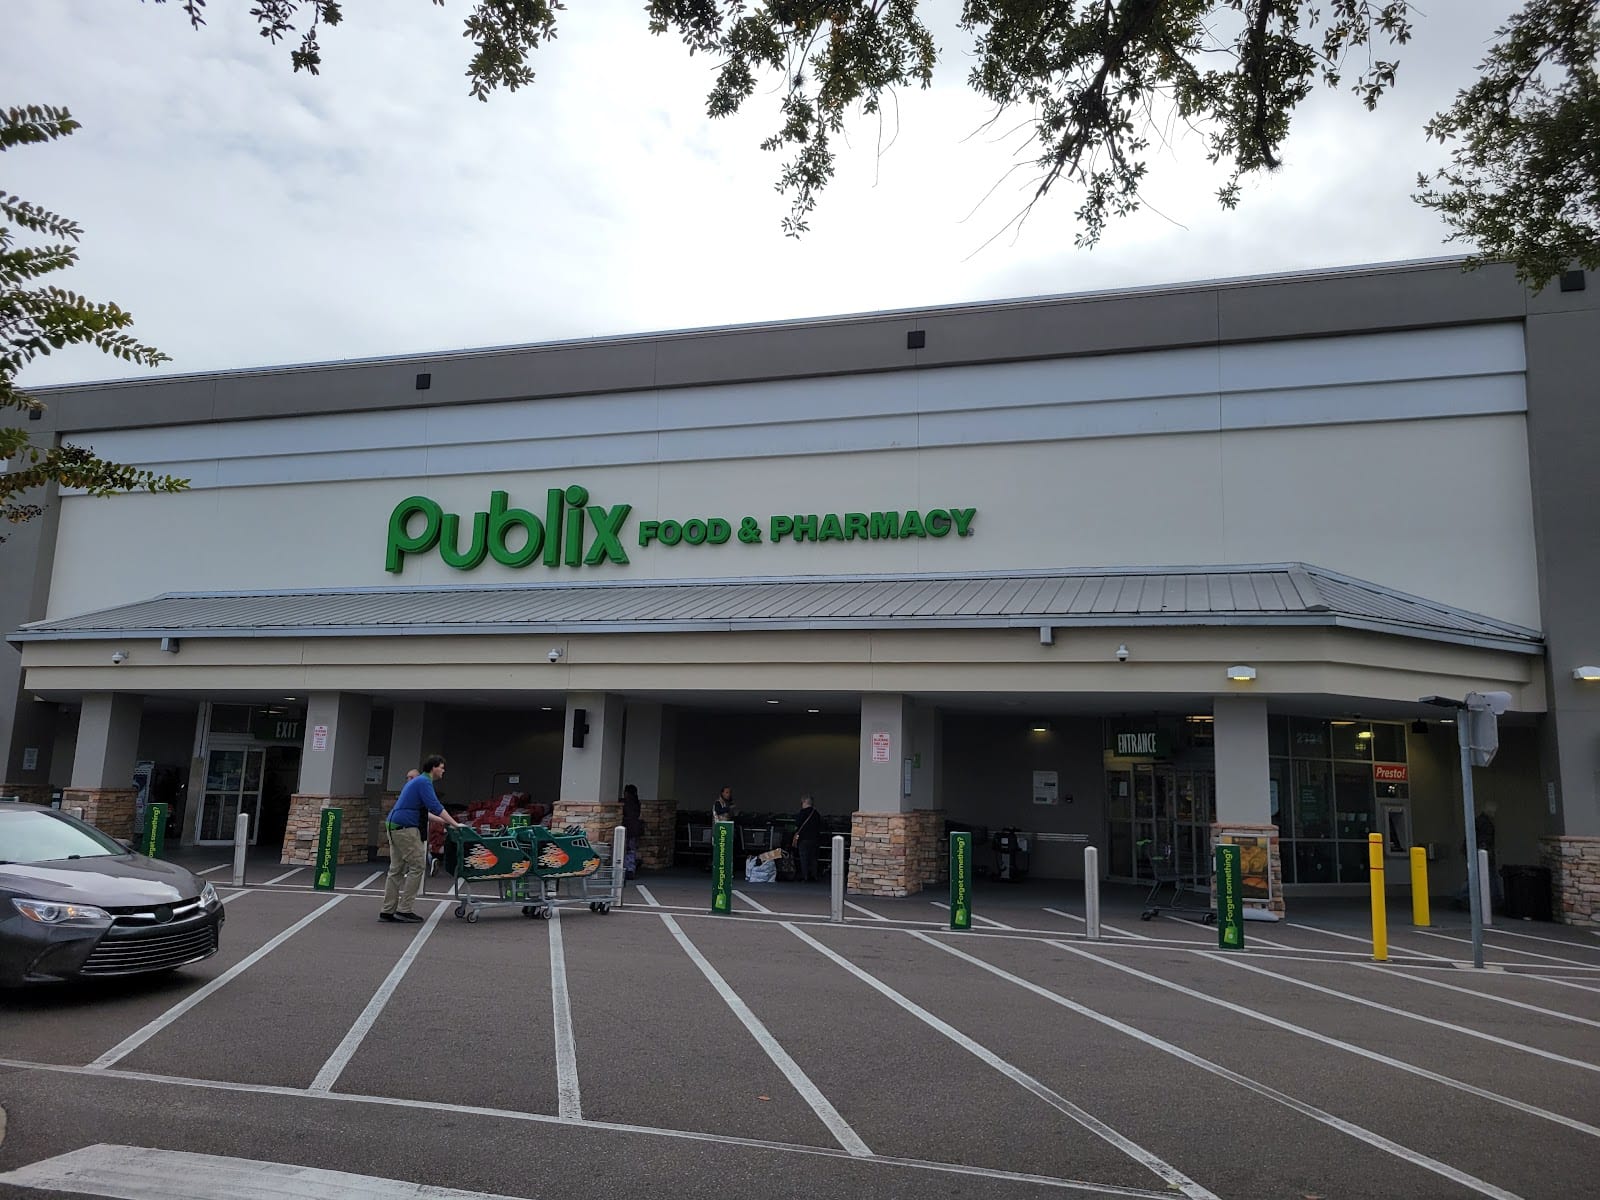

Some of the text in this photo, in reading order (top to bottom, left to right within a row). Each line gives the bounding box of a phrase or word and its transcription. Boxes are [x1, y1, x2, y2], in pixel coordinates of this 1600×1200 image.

[385, 485, 632, 573] Publix
[639, 508, 977, 547] FOOD & PHARMACY
[276, 721, 298, 738] EXIT
[1117, 733, 1157, 753] ENTRANCE
[1376, 766, 1406, 779] Presto!
[322, 811, 336, 869] Forget something?
[717, 826, 727, 890] Forget something?
[957, 836, 966, 905] Forget something?
[1222, 848, 1235, 922] Forget something?
